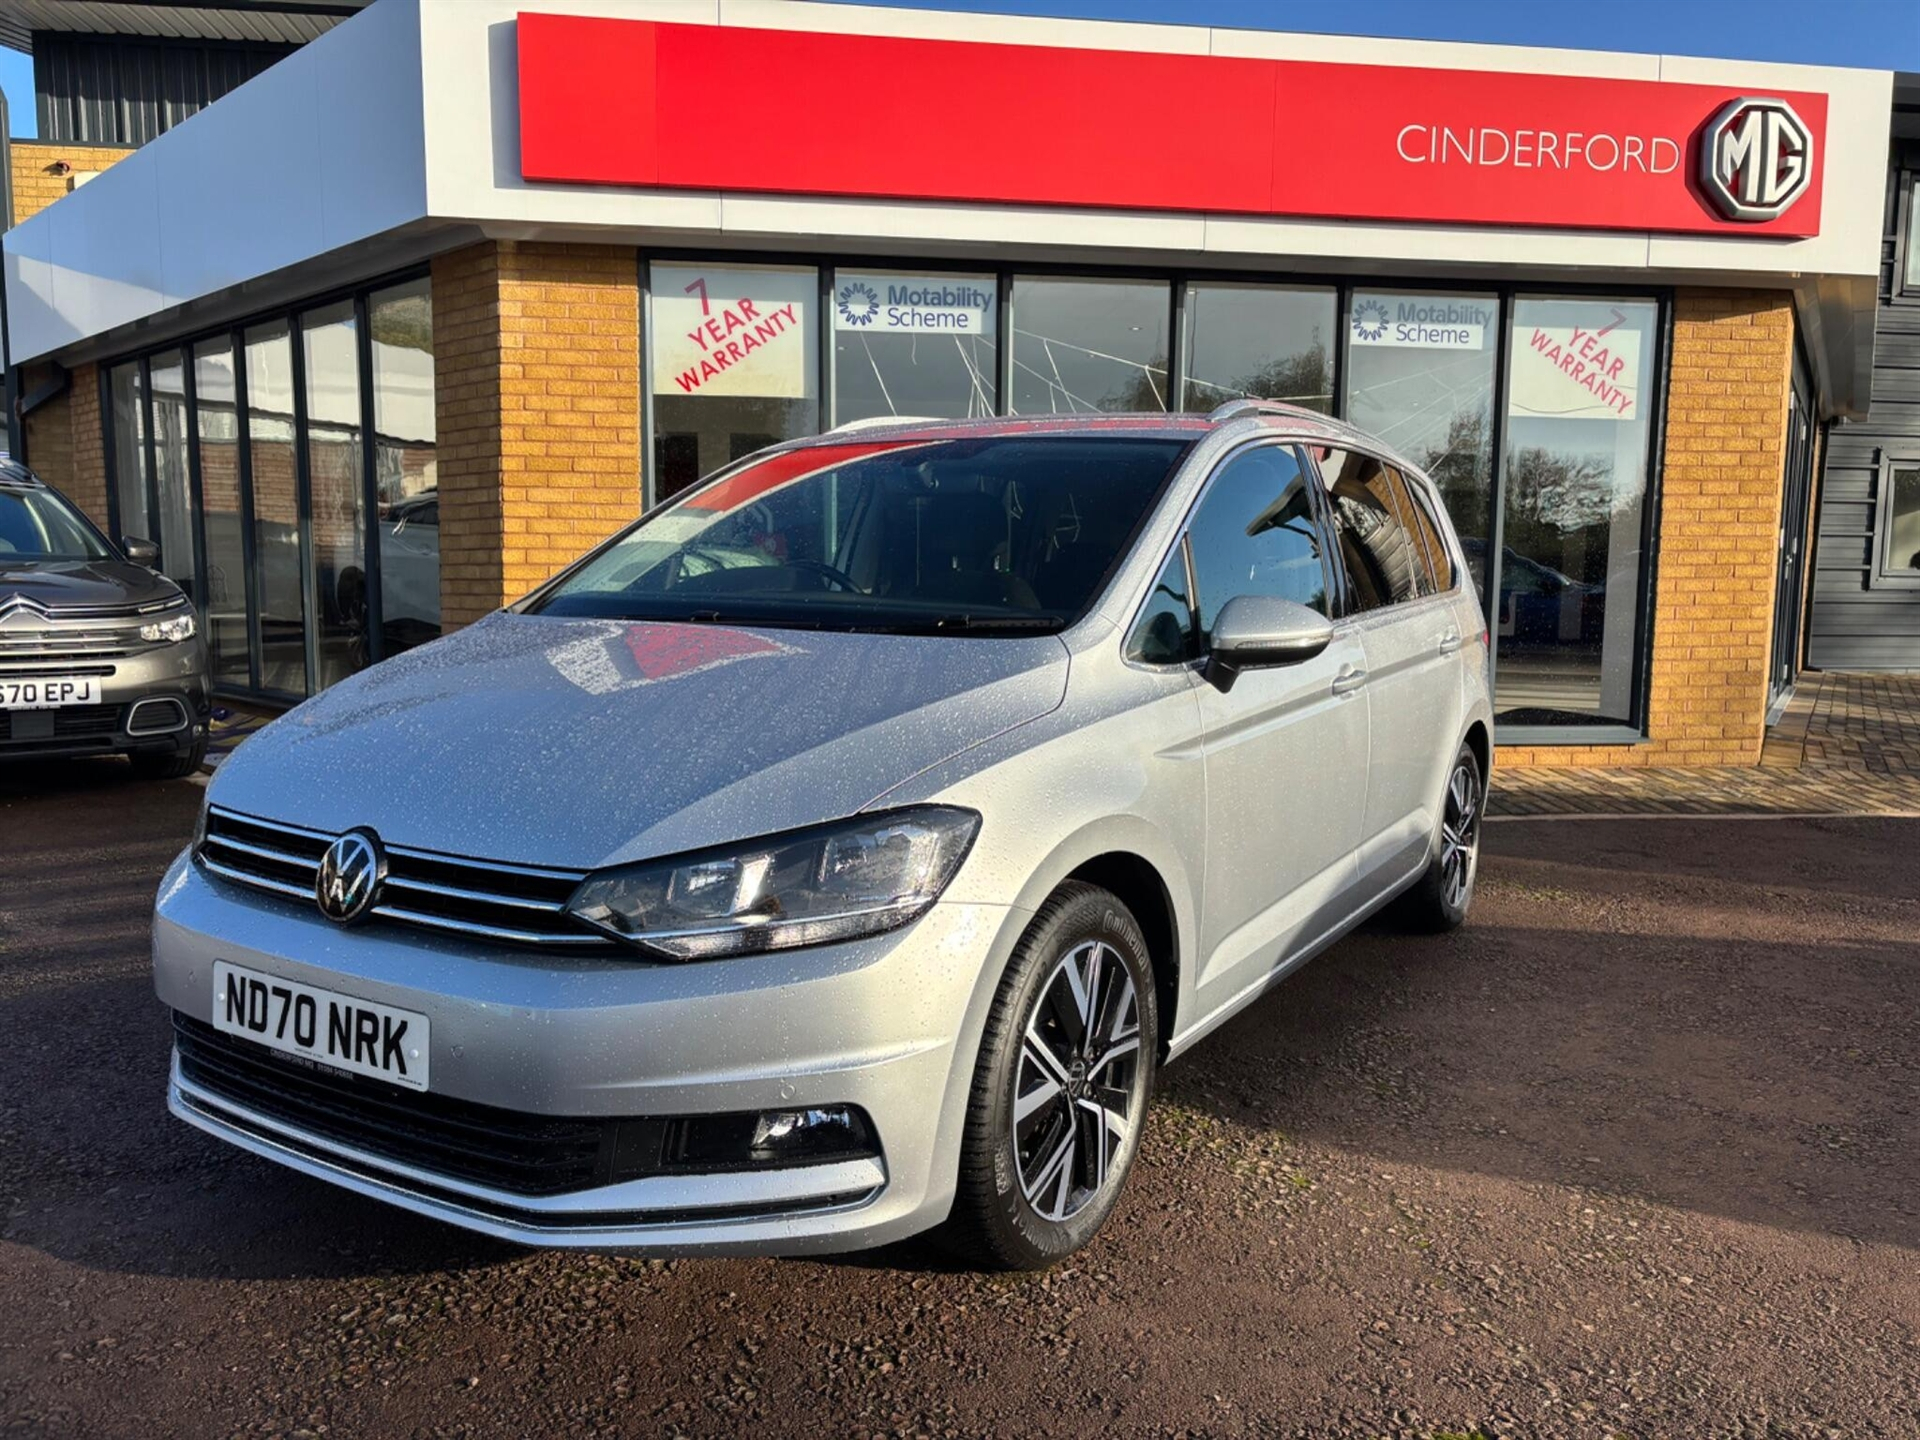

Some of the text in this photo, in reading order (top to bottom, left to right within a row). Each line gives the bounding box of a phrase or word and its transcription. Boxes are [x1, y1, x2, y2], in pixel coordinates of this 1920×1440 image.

[1396, 124, 1680, 174] CINDERFORD
[1721, 109, 1804, 204] MG
[684, 277, 711, 317] 7
[887, 307, 969, 329] Scheme
[888, 284, 994, 313] Motability
[1397, 302, 1494, 329] Motability
[687, 296, 761, 352] YEAR
[1395, 323, 1470, 345] Scheme
[1598, 307, 1628, 338] 7
[674, 303, 799, 393] WARRANTY
[1568, 325, 1625, 381] YEAR
[1529, 328, 1633, 415] WARRANTY
[45, 681, 91, 702] EPJ
[226, 972, 409, 1075] ND70 NRK
